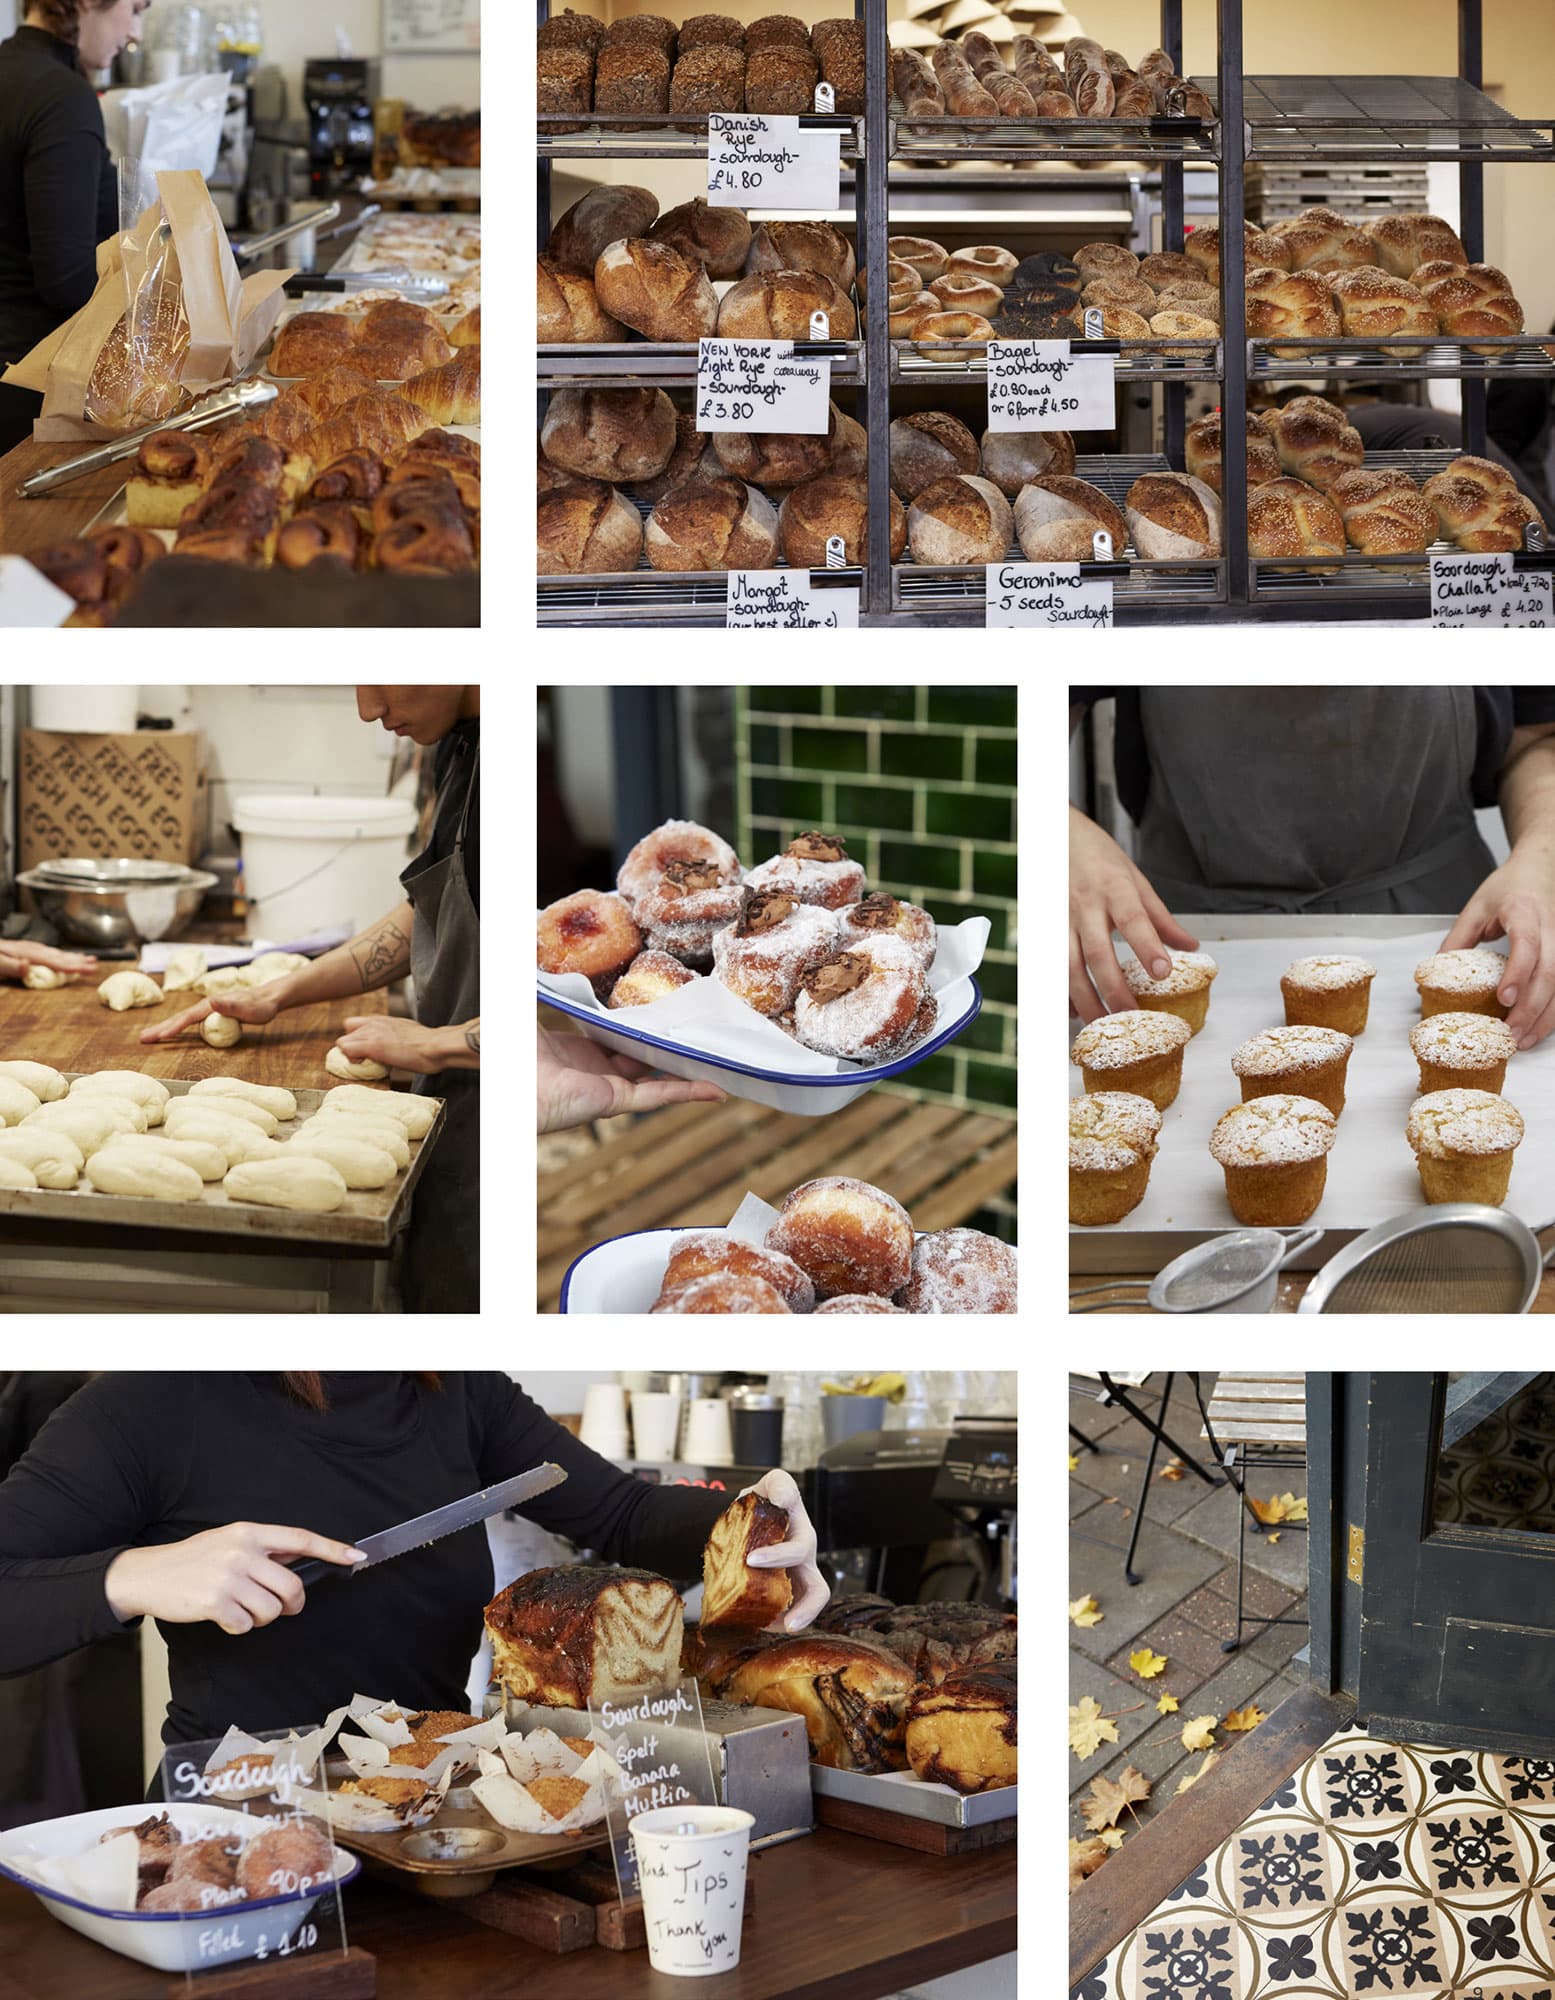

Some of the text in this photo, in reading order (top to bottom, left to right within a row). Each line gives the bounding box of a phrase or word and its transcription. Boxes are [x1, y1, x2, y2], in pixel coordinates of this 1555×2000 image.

[709, 114, 768, 131] Danish
[721, 131, 756, 154] Rye
[701, 341, 729, 356] NEW
[733, 343, 771, 359] YORK
[988, 341, 1041, 367] Bagel
[739, 359, 765, 382] Rye
[732, 574, 789, 604] Margot
[999, 566, 1083, 590] Geronimo
[1437, 579, 1498, 599] Challah
[1018, 593, 1065, 610] seeds
[602, 1688, 693, 1729] Sourdough
[616, 1735, 659, 1770] Spelt
[620, 1763, 681, 1791] Banana
[624, 1783, 690, 1818] Muffin
[674, 1860, 728, 1904] Tips
